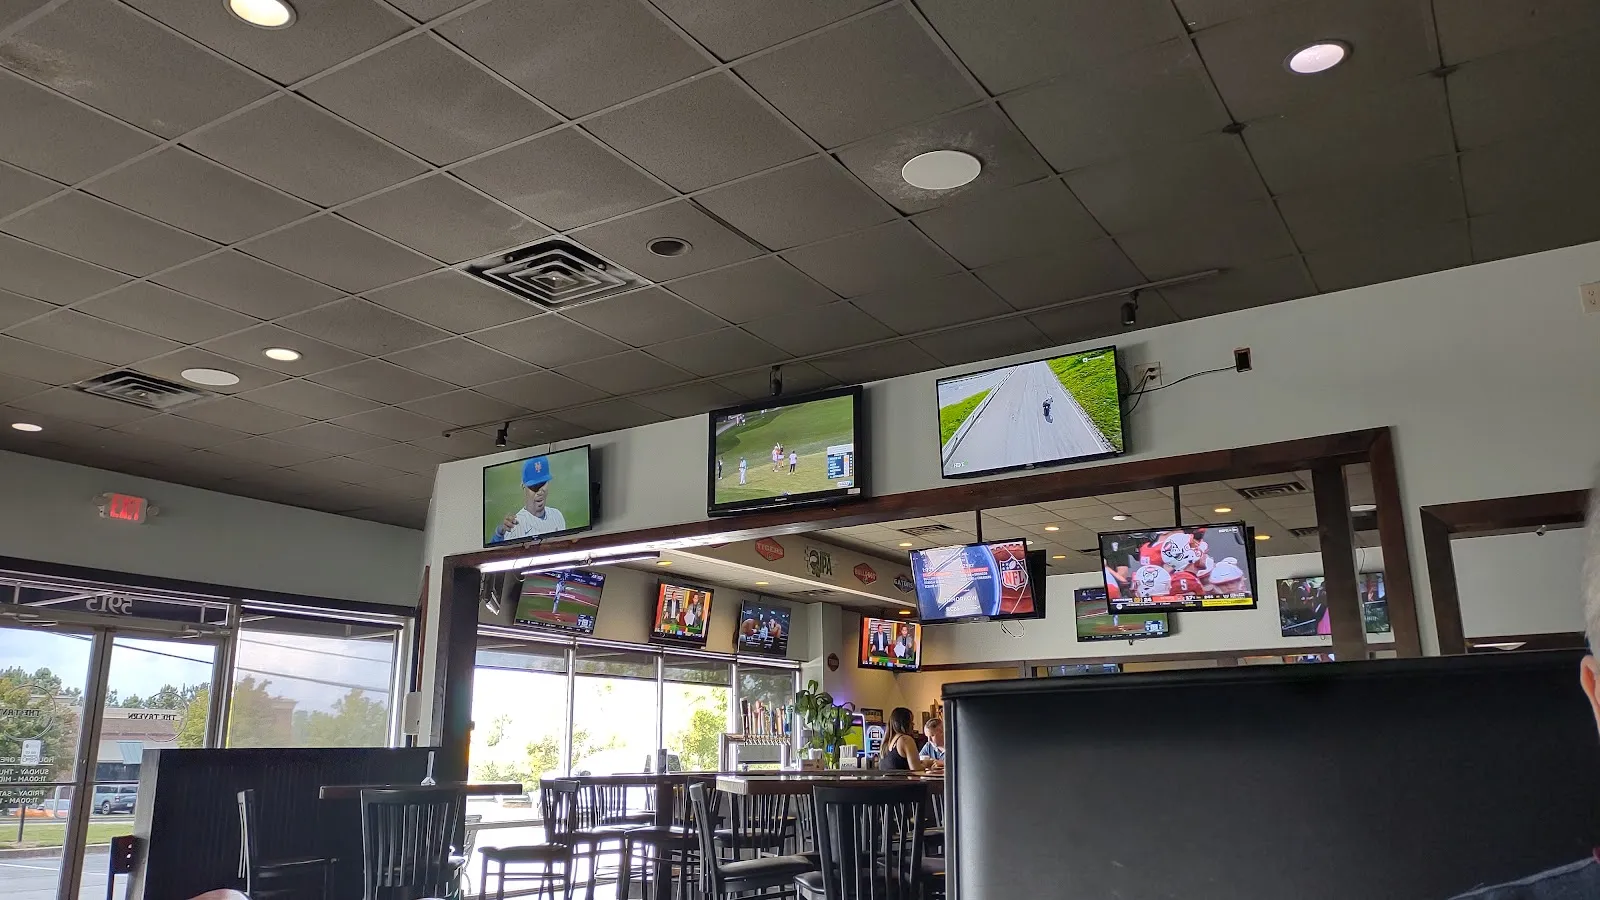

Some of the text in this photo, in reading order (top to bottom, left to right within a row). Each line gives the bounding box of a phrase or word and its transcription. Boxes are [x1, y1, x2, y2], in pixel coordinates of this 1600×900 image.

[110, 494, 144, 521] EXIT
[756, 542, 784, 556] TIGERS
[1004, 570, 1024, 586] NFL
